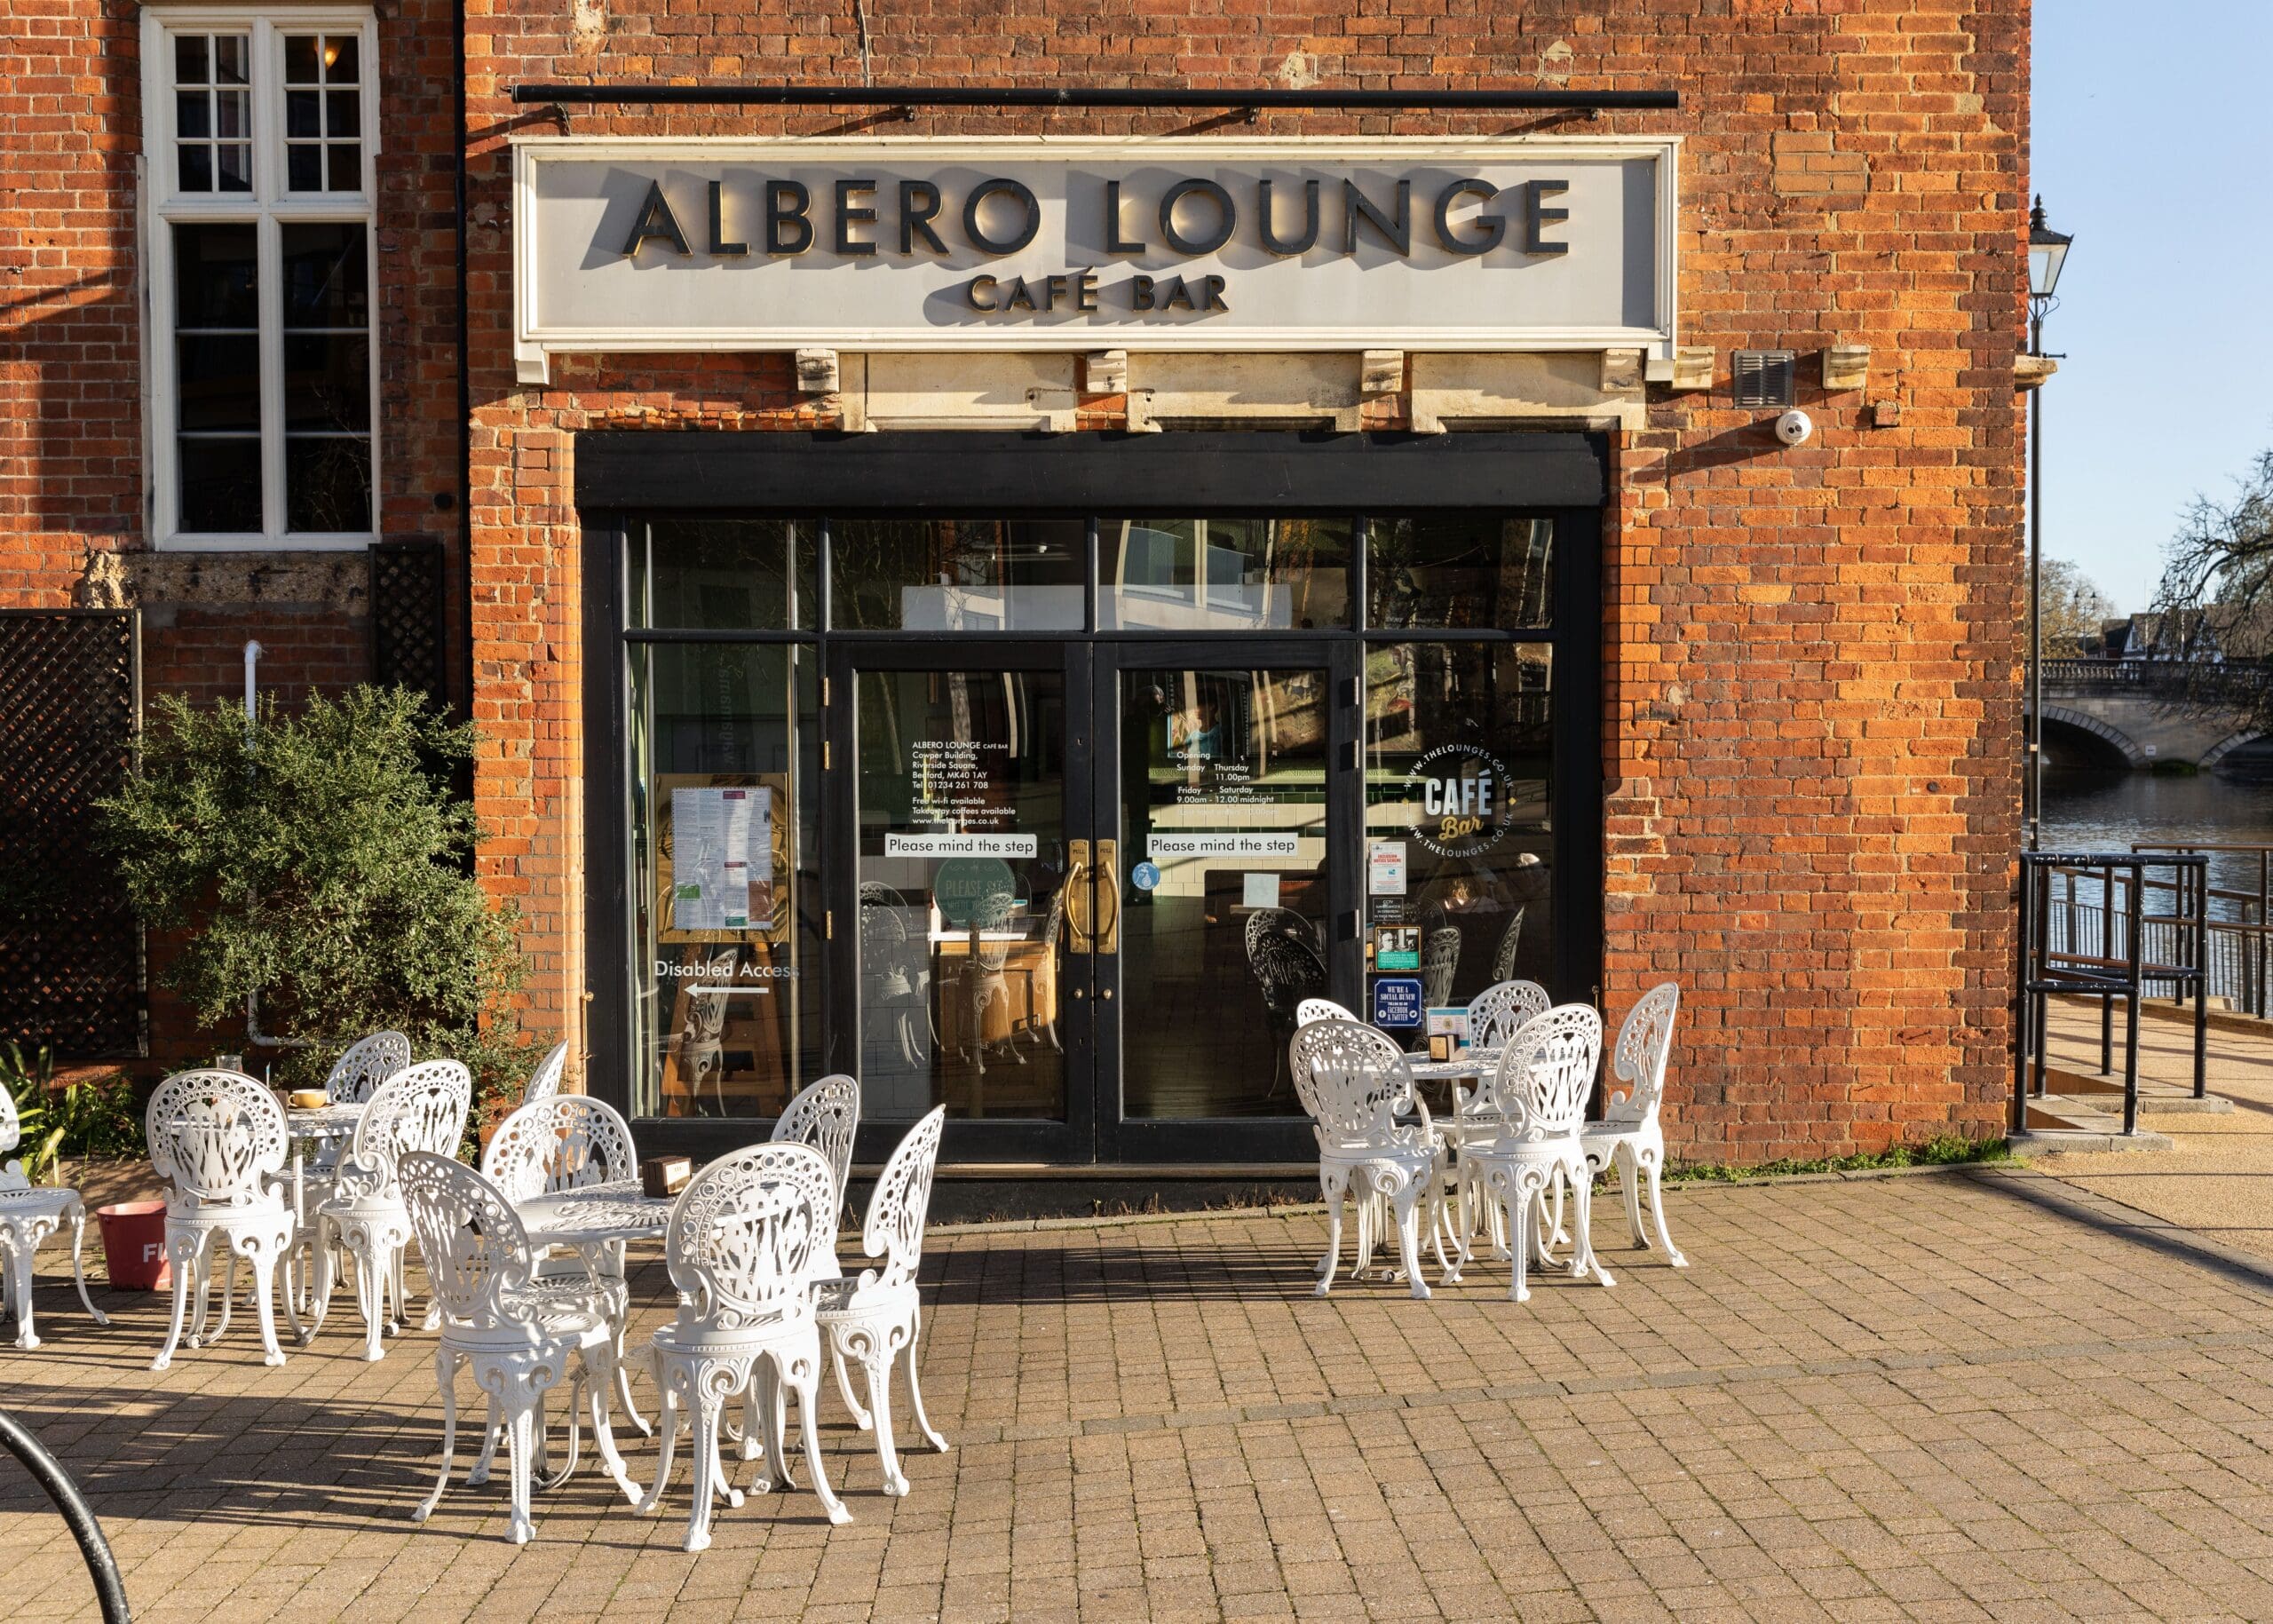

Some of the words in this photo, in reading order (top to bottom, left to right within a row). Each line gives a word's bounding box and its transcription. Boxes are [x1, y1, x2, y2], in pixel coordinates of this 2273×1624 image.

[622, 178, 1041, 257] ALBERO
[1106, 178, 1569, 257] LOUNGE
[967, 267, 1099, 313] CAFÉ
[1132, 273, 1229, 313] BAR
[912, 751, 943, 760] Cowper
[945, 751, 978, 761] Building,
[1176, 751, 1210, 761] Opening
[948, 761, 978, 771] Square,
[1176, 764, 1206, 772] Sunday
[1214, 764, 1249, 772] Thursday
[1403, 744, 1514, 788] WWW.THELOUNGES.CO.UK
[1216, 773, 1250, 782] 11.00pm
[1177, 786, 1201, 796] Friday
[1219, 786, 1254, 795] Saturday
[1425, 768, 1493, 816] CAFÉ
[1239, 796, 1274, 804] midnight
[912, 806, 950, 816] Takeaway
[1438, 816, 1484, 841] Bar
[889, 839, 934, 852] Please
[939, 839, 973, 852] mind
[978, 839, 1001, 852] the
[1004, 841, 1034, 854] step
[1151, 839, 1195, 852] Please
[1200, 838, 1235, 852] mind
[1239, 838, 1262, 852] the
[1266, 840, 1295, 853] step
[946, 880, 982, 897] PLEASE
[654, 960, 733, 977] Disabled
[740, 961, 799, 977] Access
